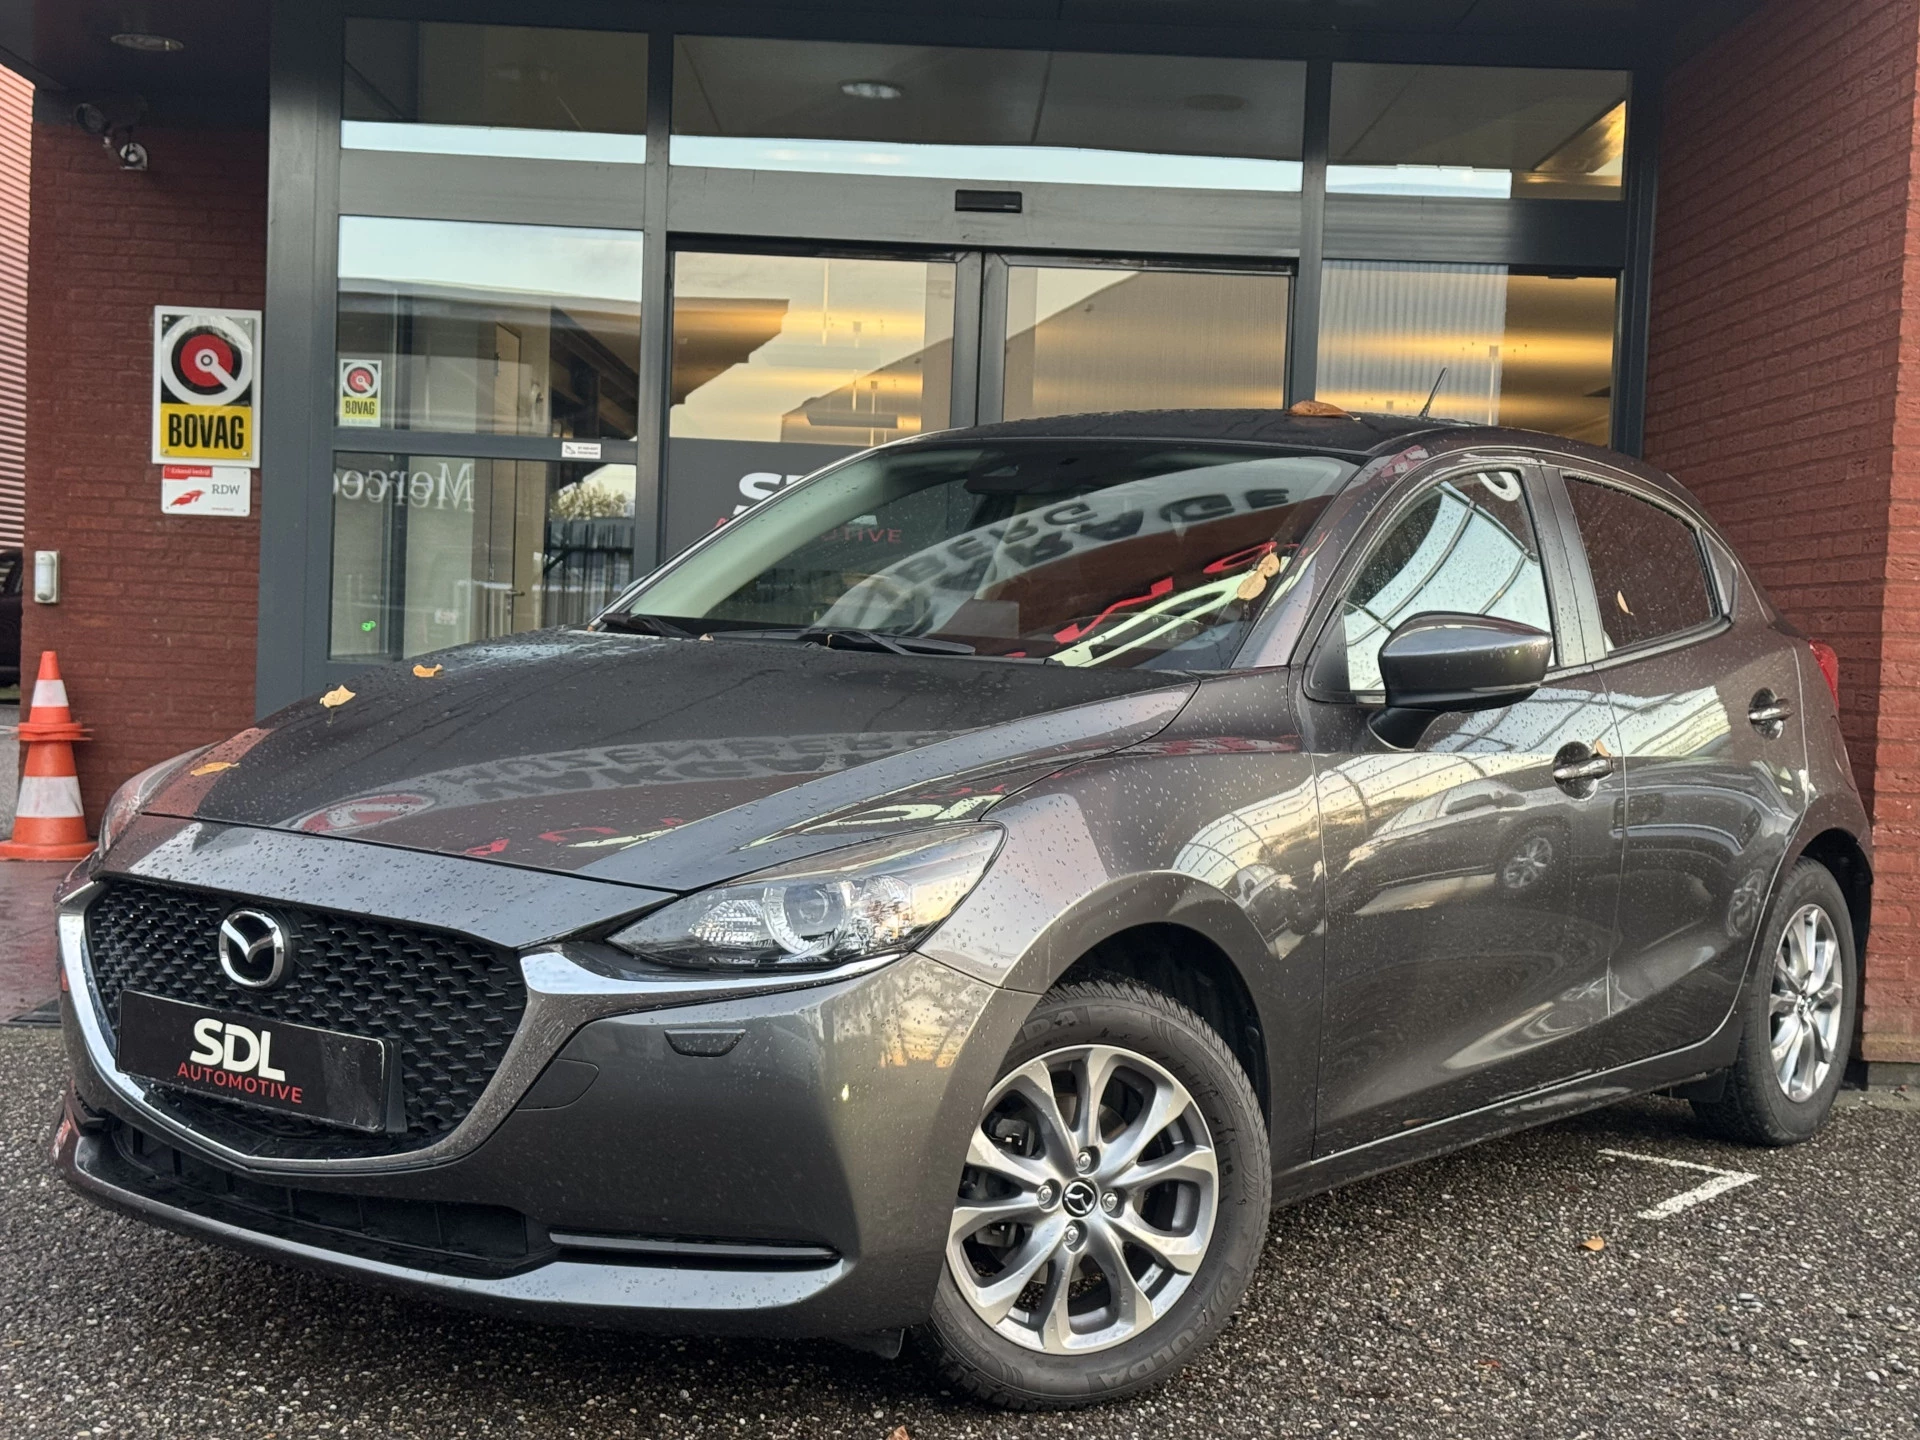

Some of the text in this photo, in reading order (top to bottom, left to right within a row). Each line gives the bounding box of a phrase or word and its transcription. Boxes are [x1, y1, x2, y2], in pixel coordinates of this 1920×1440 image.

[345, 400, 375, 416] BOVAG
[168, 413, 244, 449] BOVAG
[212, 485, 240, 495] RDW
[189, 1018, 286, 1082] SDL
[177, 1062, 303, 1104] AUTOMOTIVE
